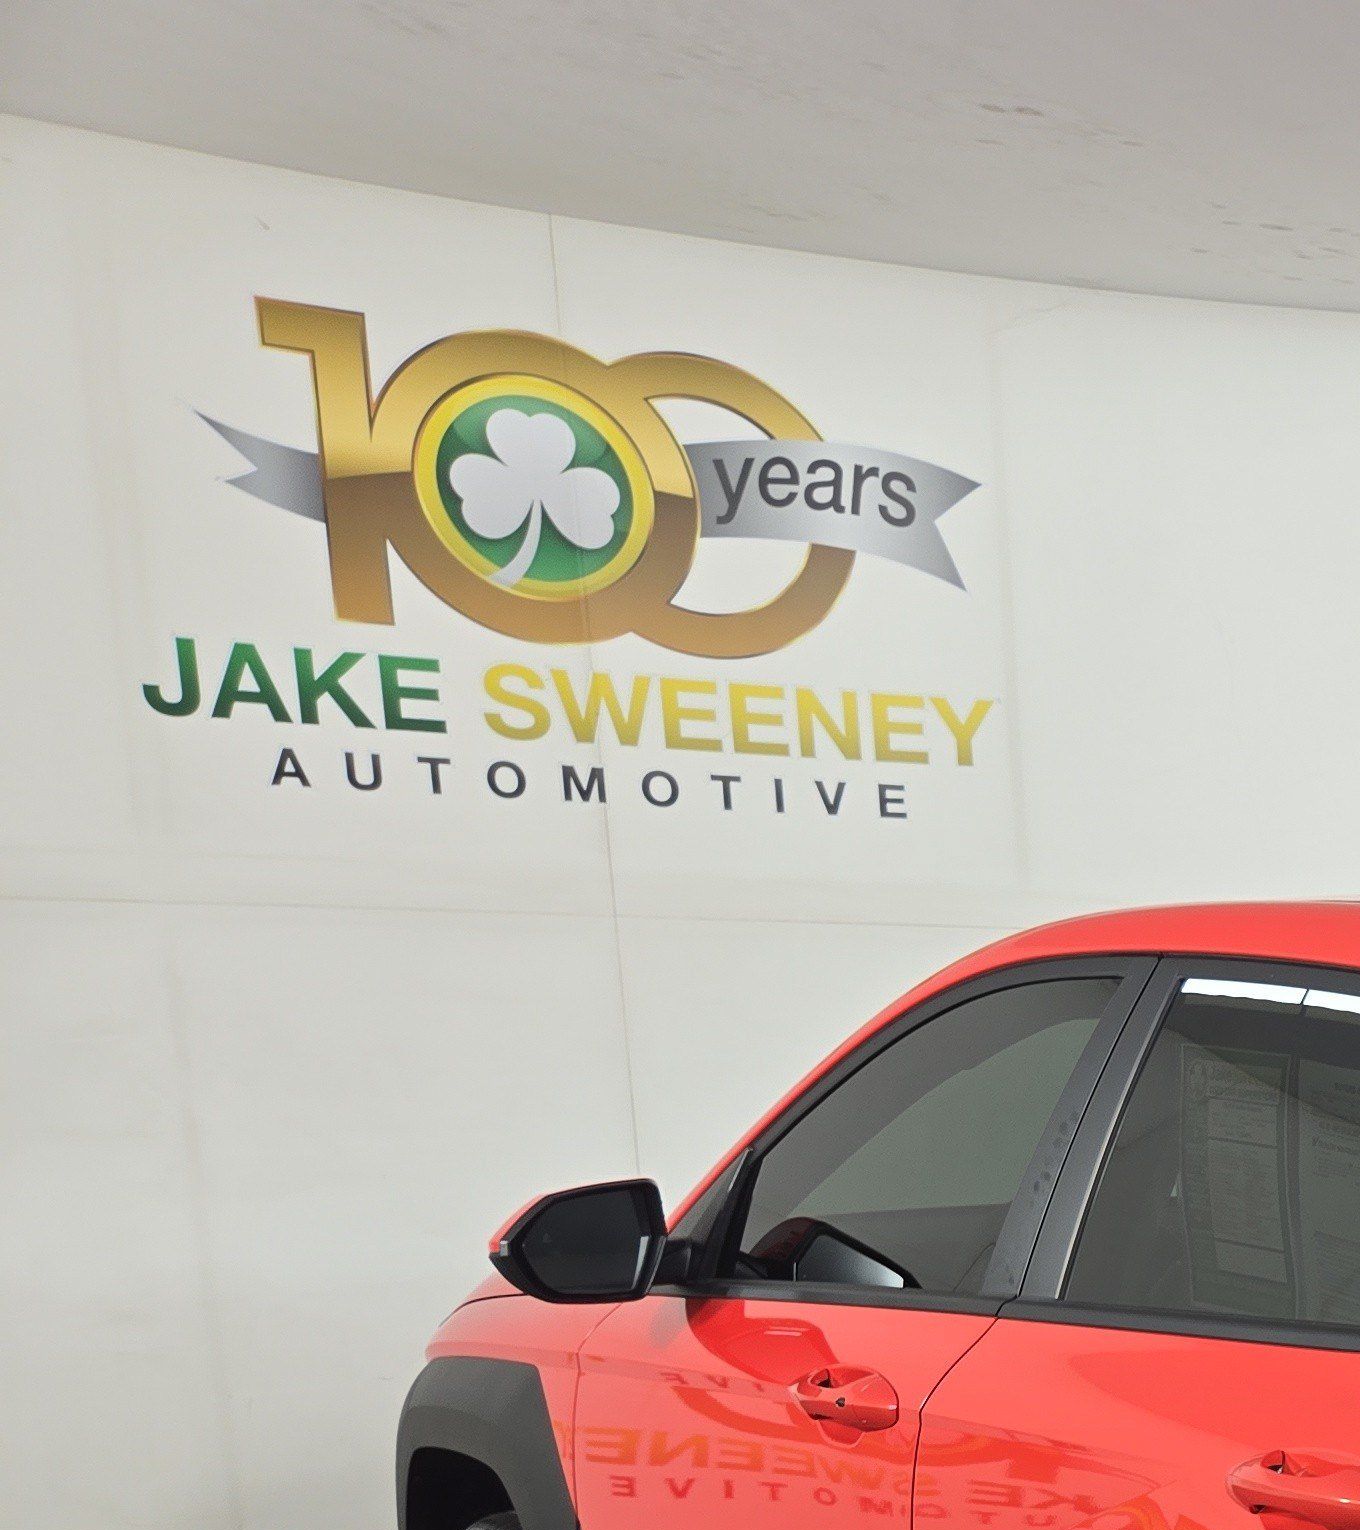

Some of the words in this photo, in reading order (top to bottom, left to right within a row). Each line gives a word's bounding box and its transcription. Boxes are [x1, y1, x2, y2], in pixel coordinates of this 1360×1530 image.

[713, 455, 918, 528] years
[142, 637, 449, 735] JAKE
[482, 664, 995, 768] SWEENEY
[271, 748, 908, 820] AUTOMOTIVE
